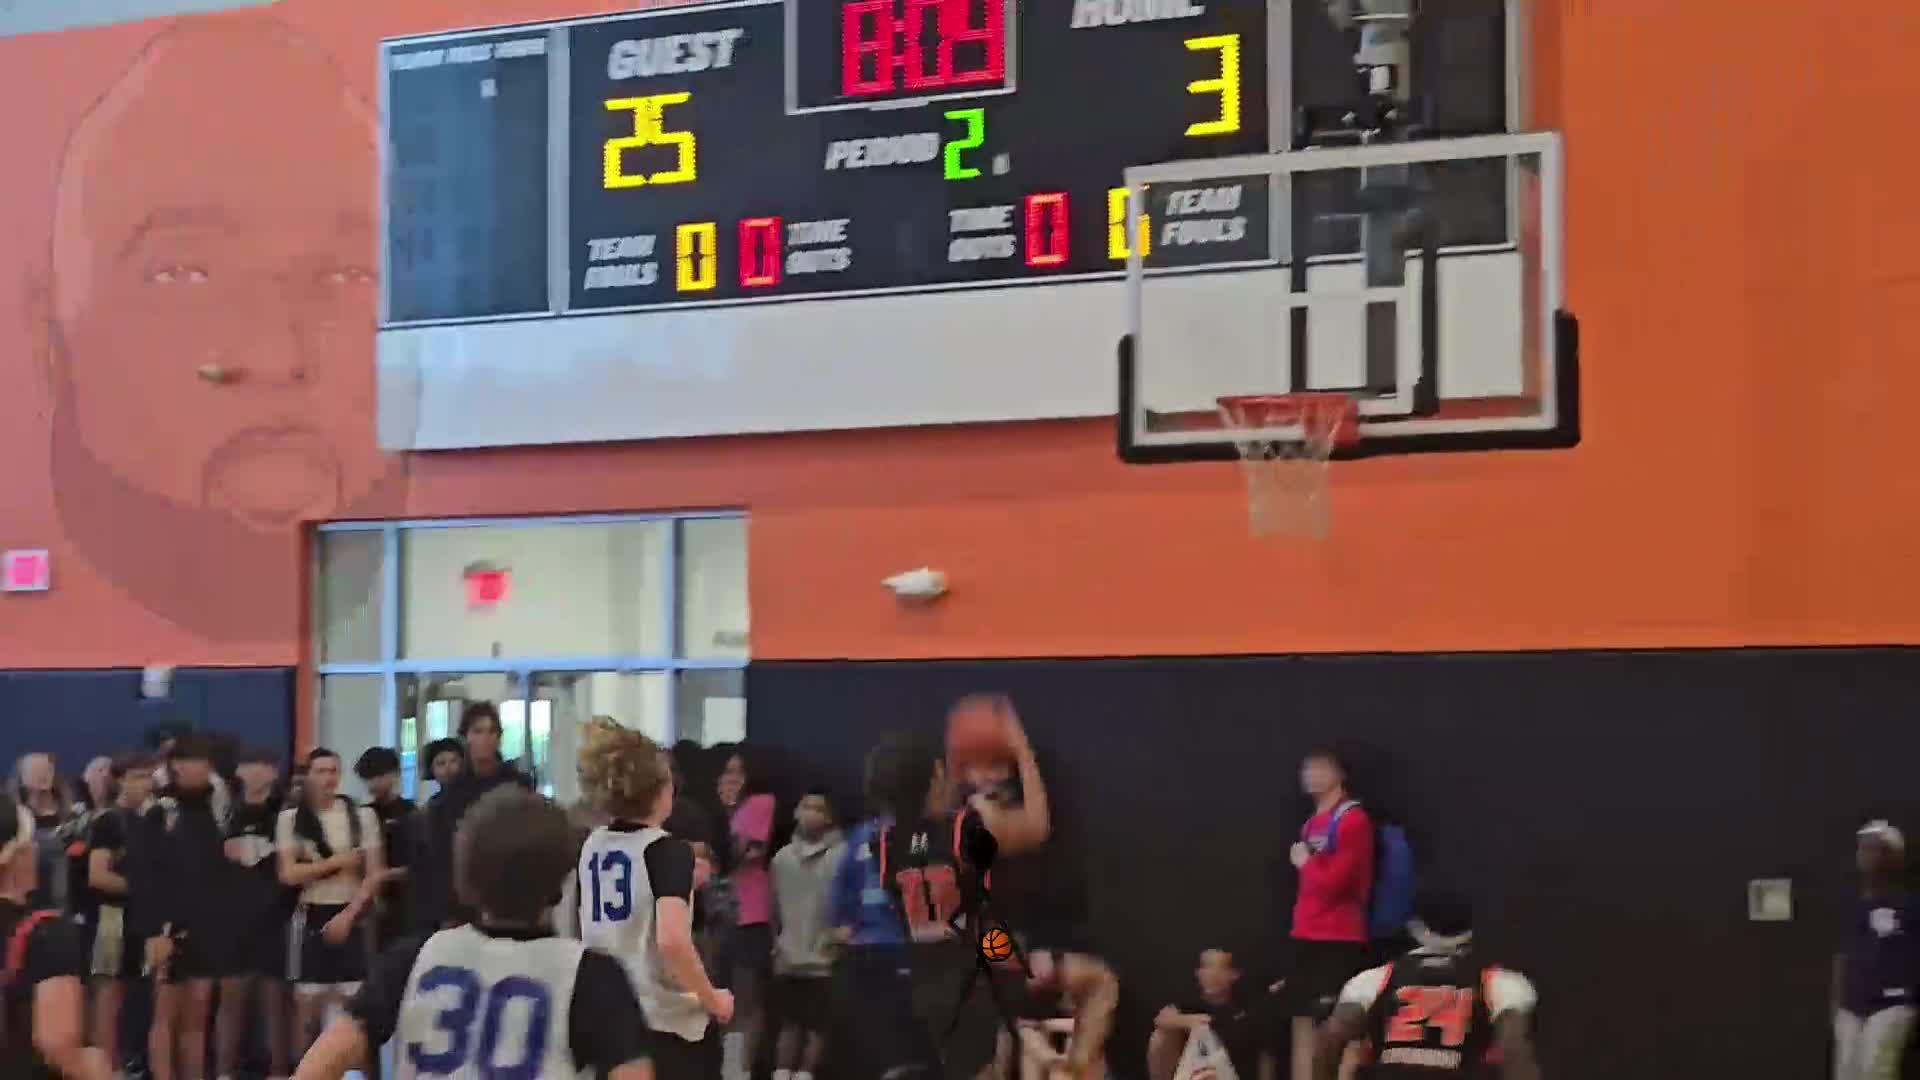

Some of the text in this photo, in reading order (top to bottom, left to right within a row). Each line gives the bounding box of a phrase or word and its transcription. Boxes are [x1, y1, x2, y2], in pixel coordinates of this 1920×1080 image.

[608, 27, 745, 80] GUEST
[1184, 34, 1240, 136] 3
[603, 92, 696, 188] 25
[944, 108, 985, 180] 2
[676, 222, 718, 292] 0
[738, 216, 784, 287] 0
[1024, 192, 1070, 266] 0
[588, 850, 632, 922] 13
[408, 966, 551, 1080] 30
